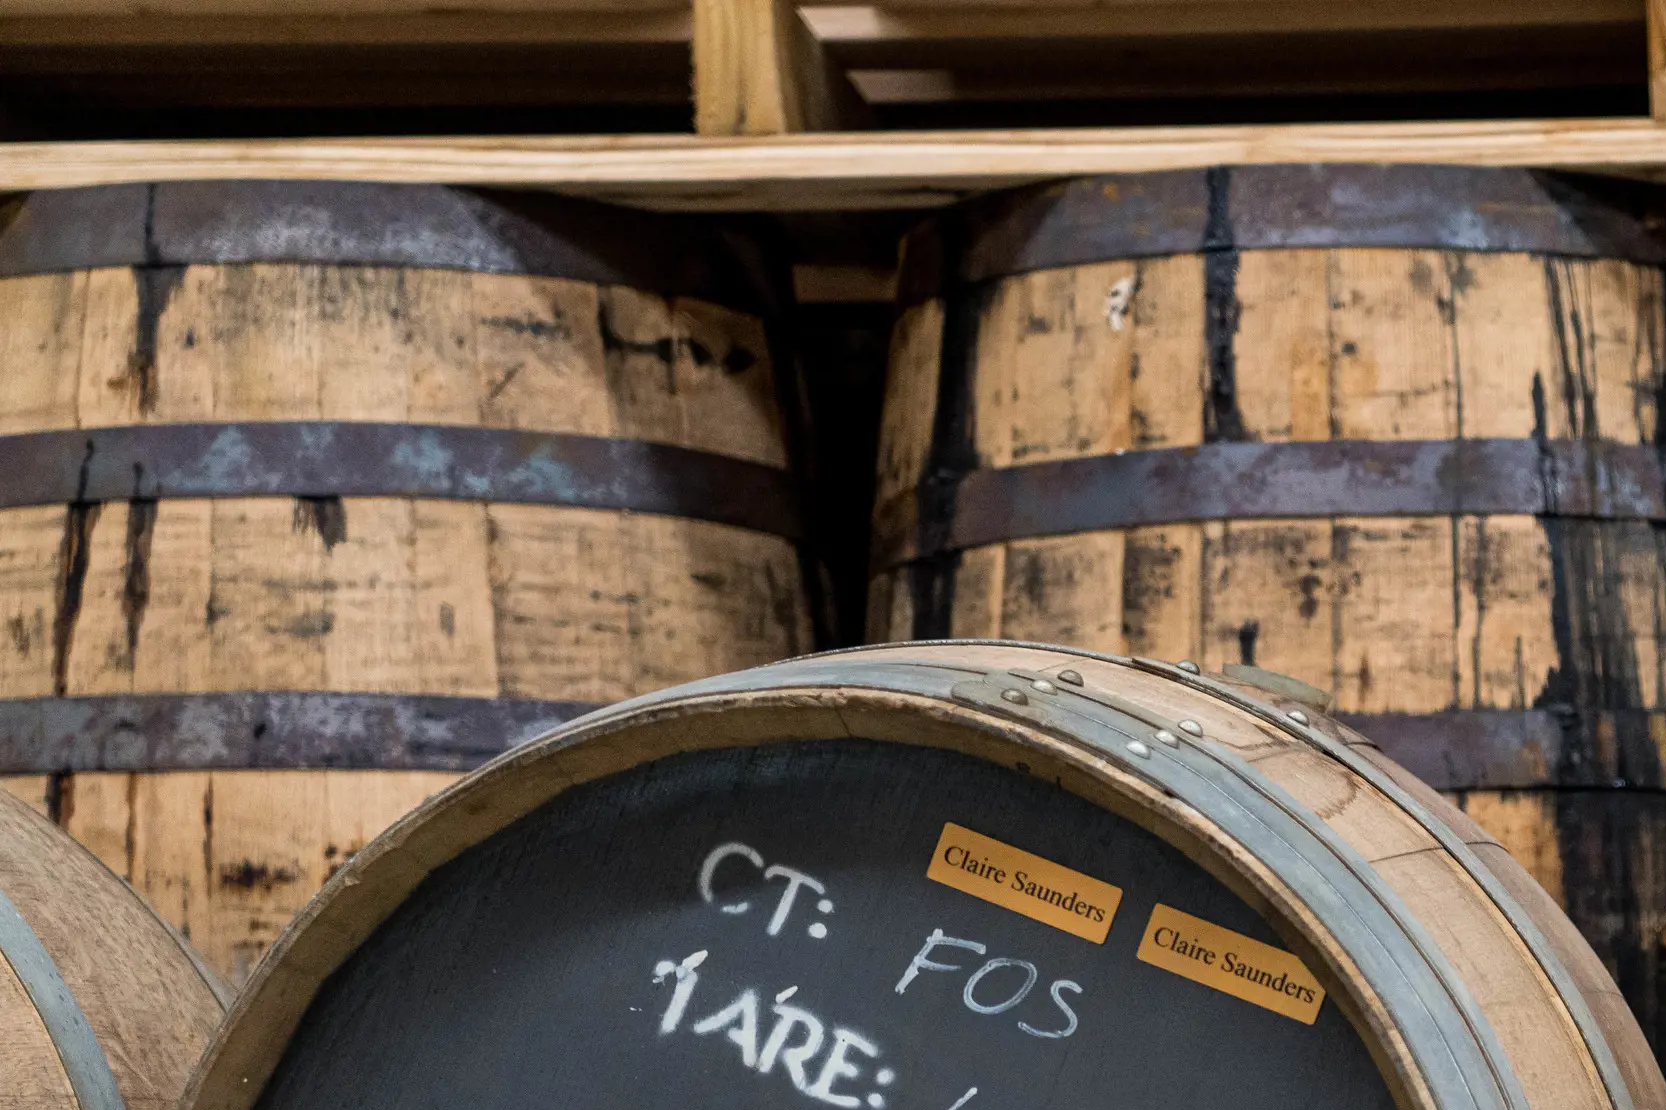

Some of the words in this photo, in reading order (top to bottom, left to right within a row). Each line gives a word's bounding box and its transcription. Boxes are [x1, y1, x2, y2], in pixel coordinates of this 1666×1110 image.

[943, 845, 1007, 885] Claire
[1010, 870, 1107, 923] Saunders
[698, 841, 835, 940] CT:
[893, 927, 1084, 1039] FOS
[1153, 926, 1217, 966] Claire
[1220, 951, 1317, 1005] Saunders
